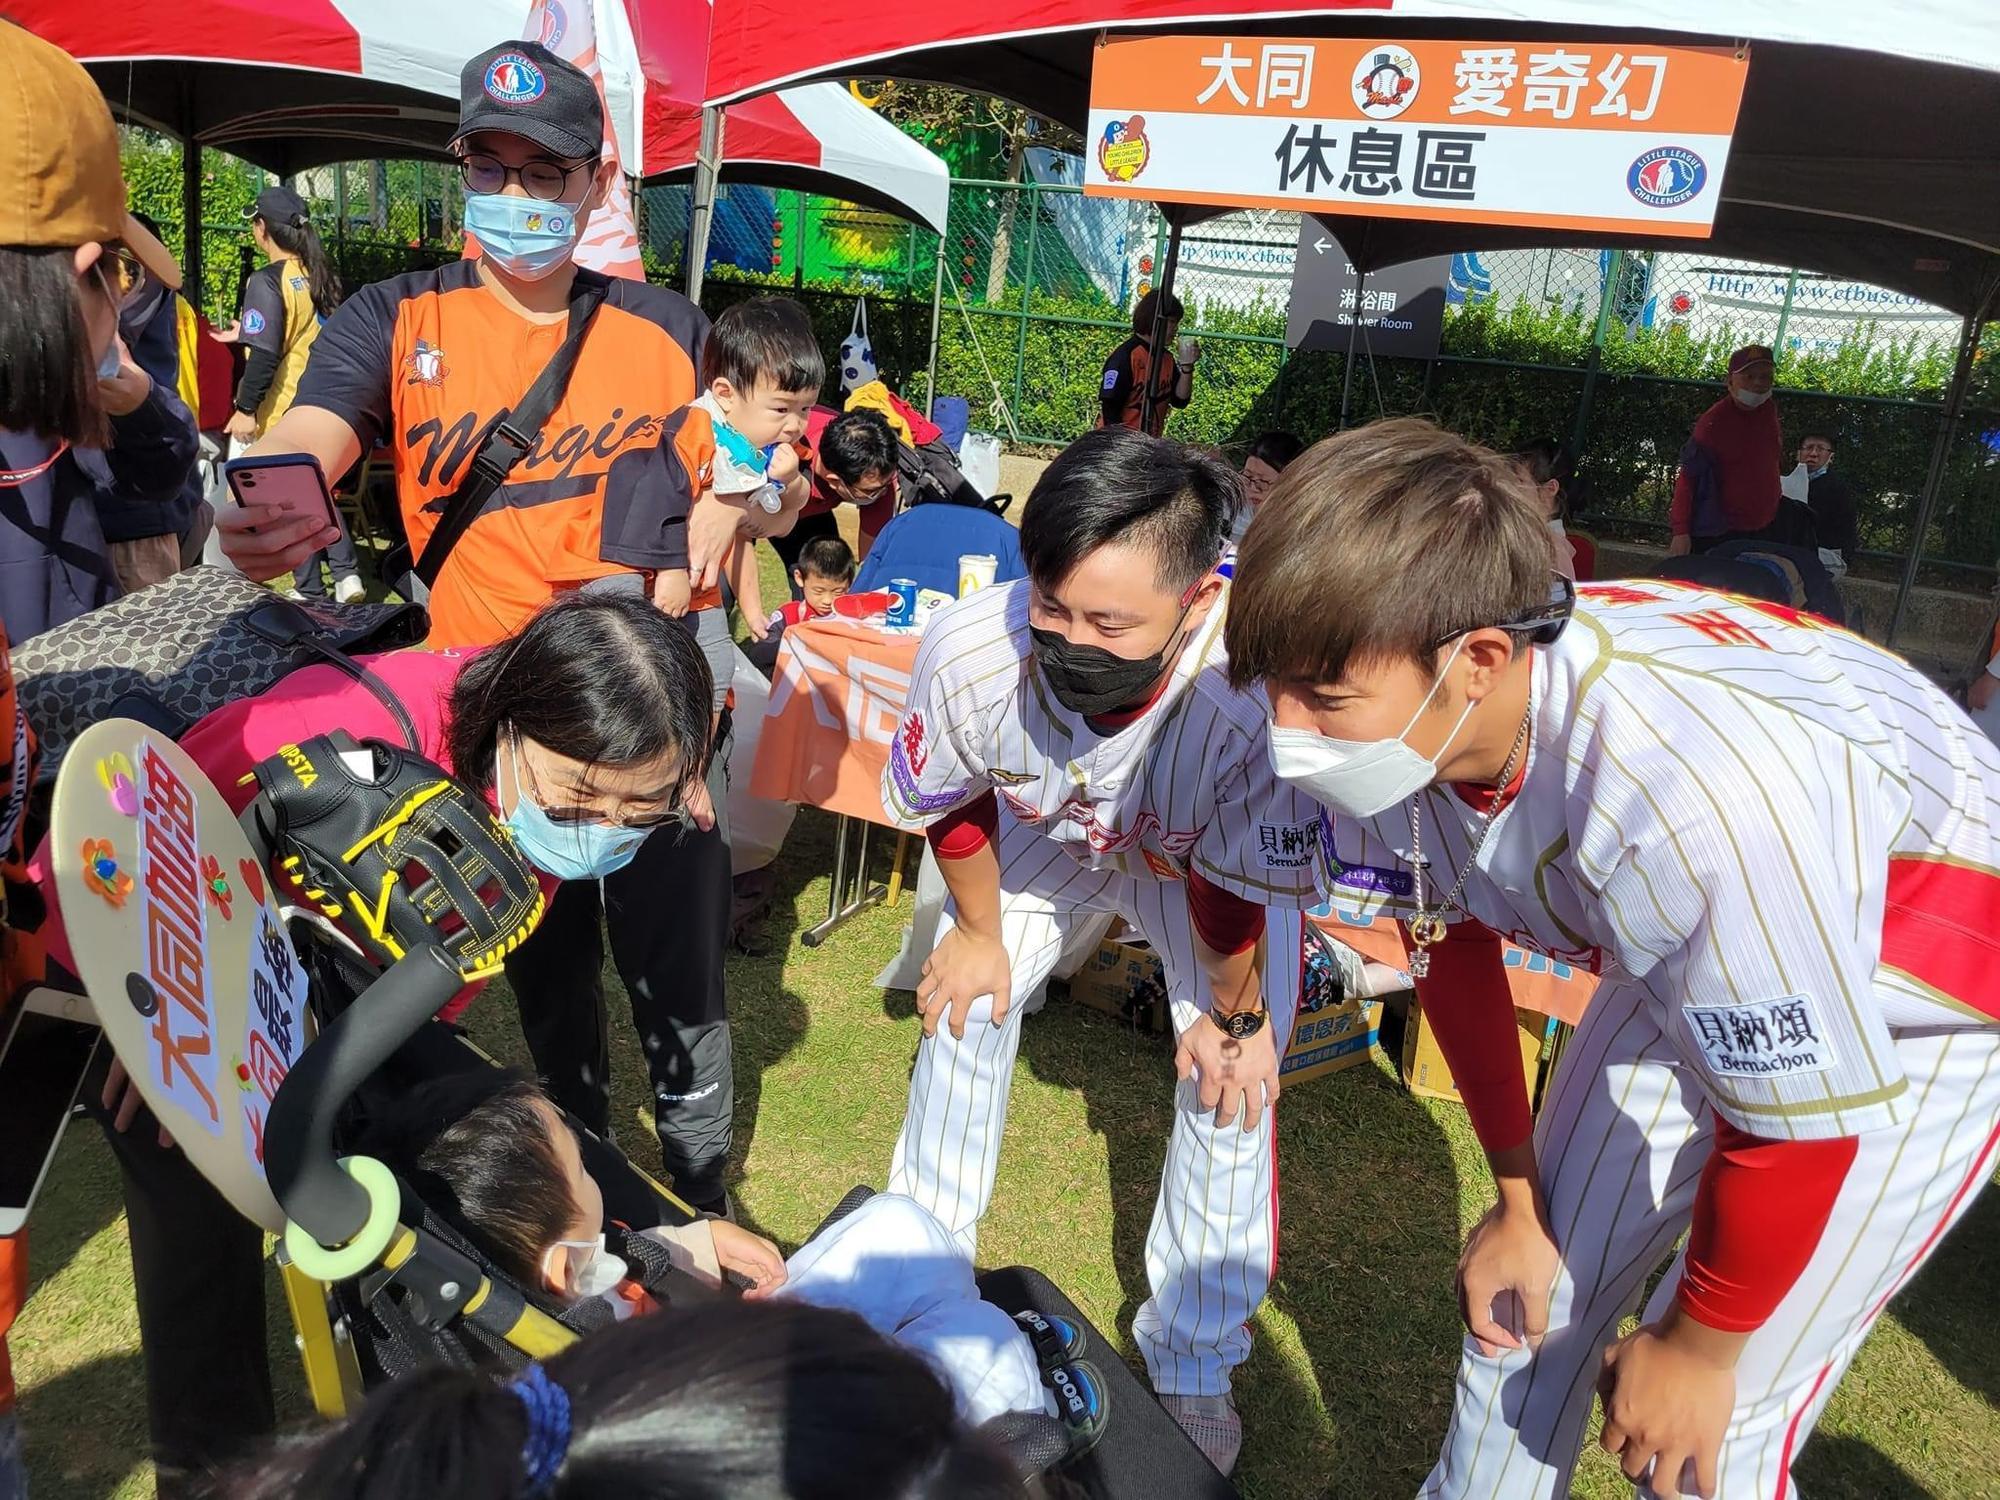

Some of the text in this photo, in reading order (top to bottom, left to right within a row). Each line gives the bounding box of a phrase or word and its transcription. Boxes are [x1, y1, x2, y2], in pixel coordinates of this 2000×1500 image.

[513, 55, 540, 77] LEAGUE
[1196, 42, 1668, 120] 大同 愛奇幻
[488, 85, 537, 101] CHALLENGER
[1274, 124, 1487, 201] 休息區
[1637, 149, 1701, 170] LITTLE LEAGUE
[1634, 187, 1693, 205] CHALLENGER
[1337, 313, 1413, 330] Shwer Room
[1265, 854, 1313, 867] Bernach
[141, 744, 220, 1122] 大同加油
[1692, 1000, 1819, 1054] 貝納頌
[1717, 1052, 1818, 1073] Bernachon
